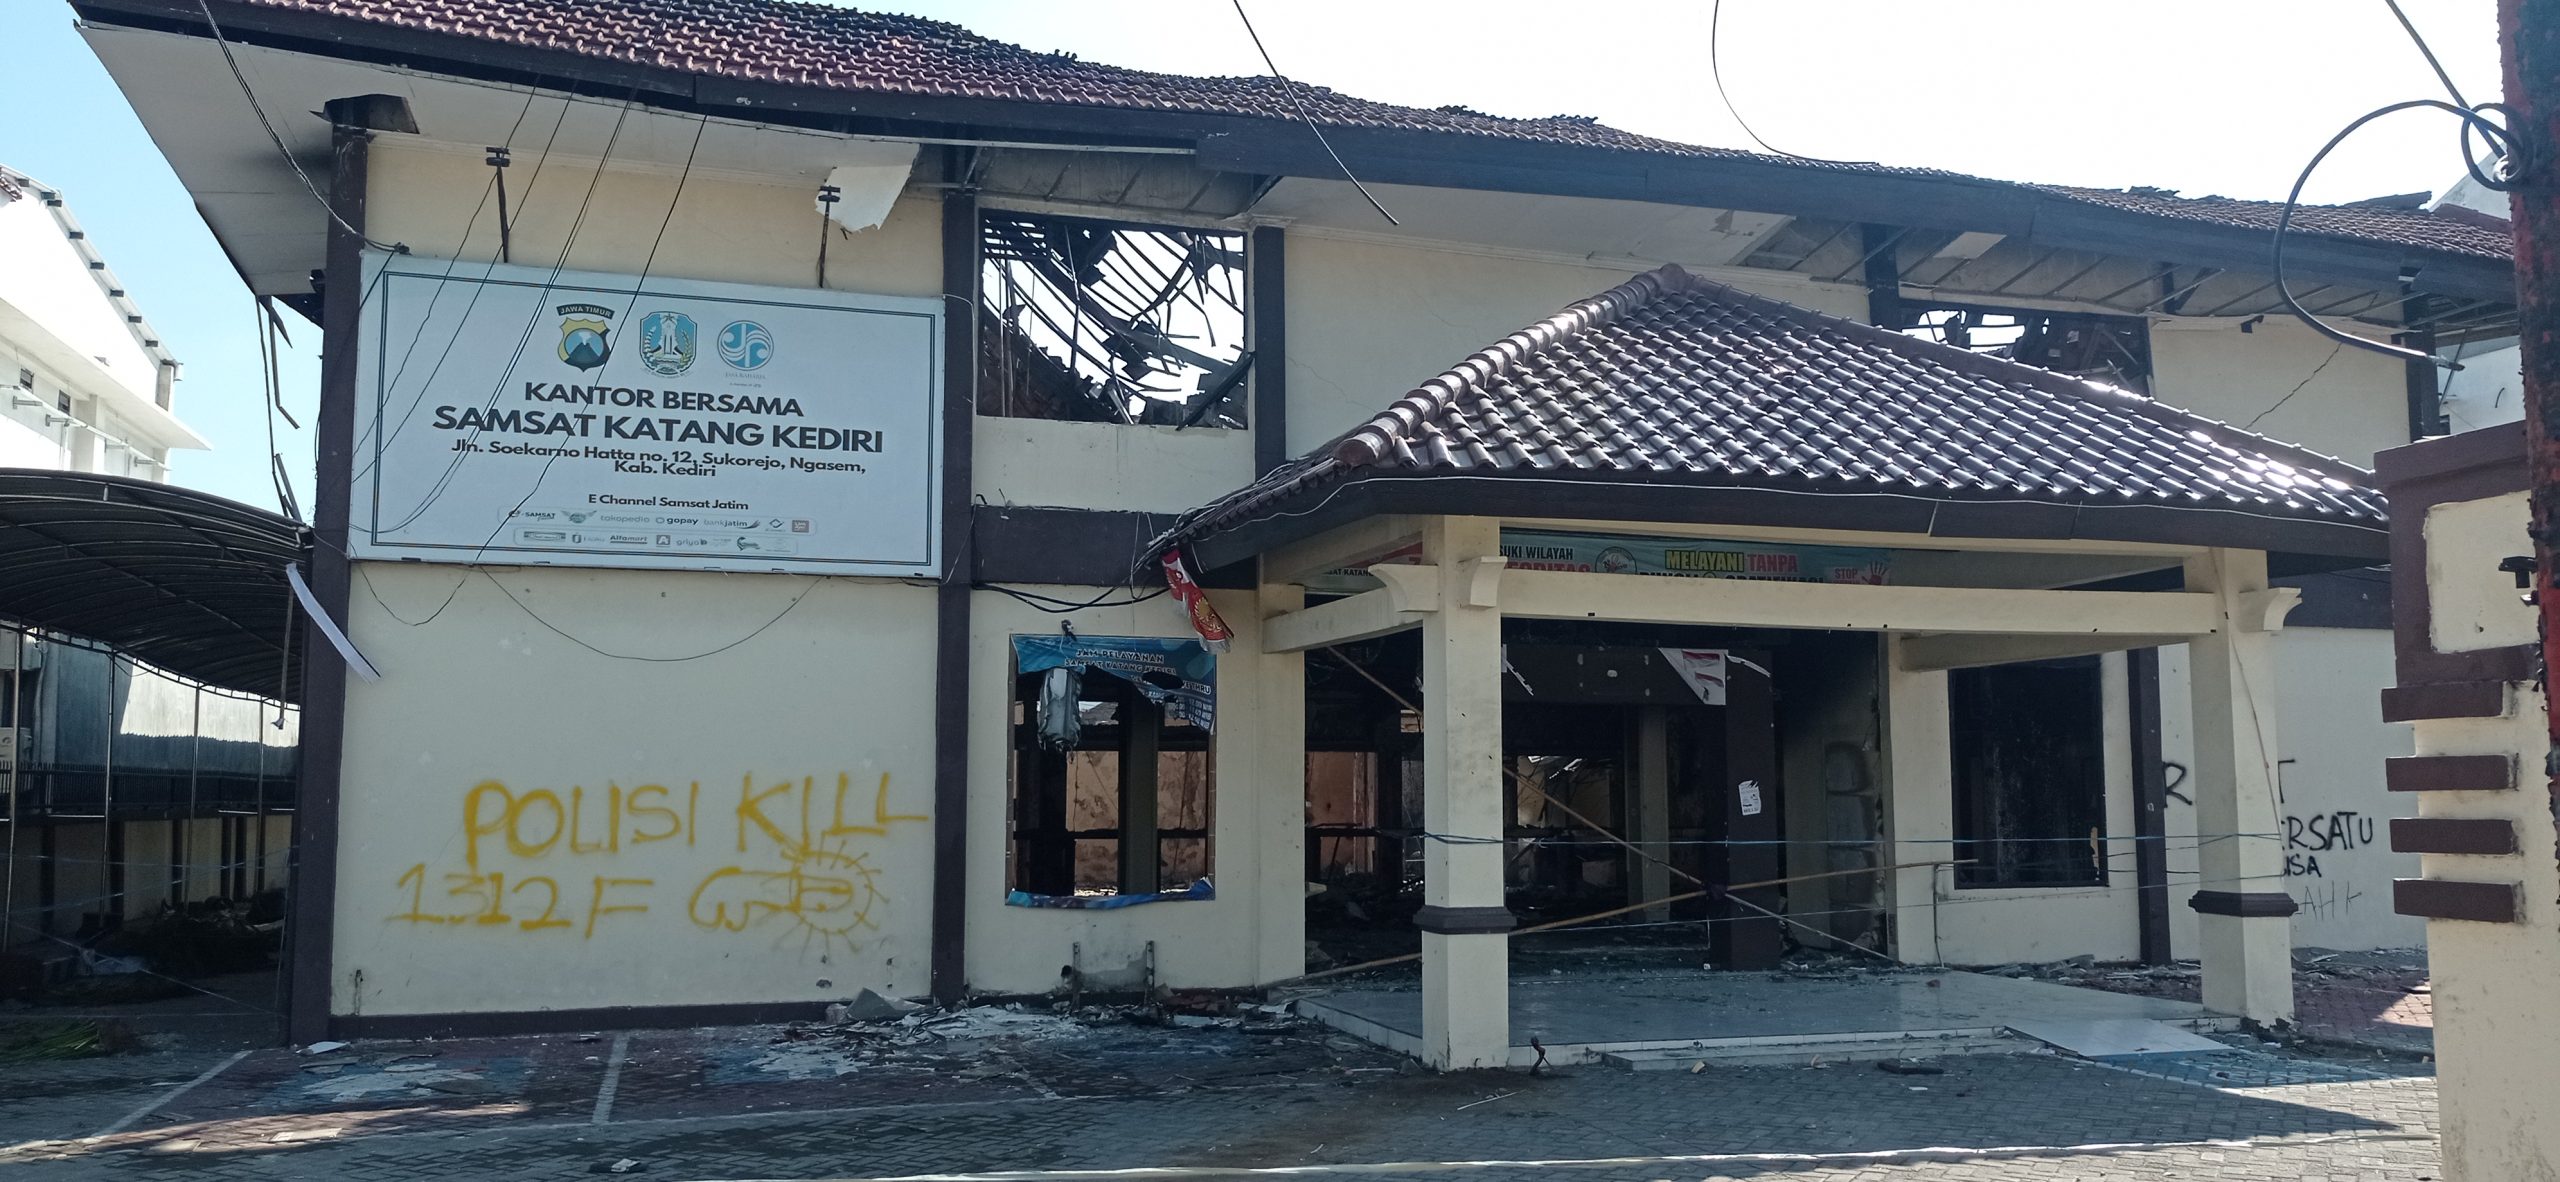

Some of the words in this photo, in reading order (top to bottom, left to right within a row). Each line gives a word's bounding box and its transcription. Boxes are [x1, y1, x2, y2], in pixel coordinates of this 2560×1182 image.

[560, 305, 583, 315] JAWA
[585, 305, 612, 318] TIMUR
[525, 382, 656, 409] KANTOR
[663, 390, 804, 417] BERSAMA
[432, 405, 596, 437] SAMSAT
[604, 415, 764, 446] KATANG
[772, 425, 883, 453] KEDIRI
[451, 438, 484, 452] Jln.
[489, 441, 580, 457] Soekarno
[584, 446, 635, 461] Hatta
[640, 451, 667, 462] no.
[672, 451, 698, 465] 12,
[702, 452, 785, 471] Sukorejo,
[790, 456, 866, 475] Ngasem,
[614, 460, 658, 474] Kab.
[663, 462, 716, 477] Kediri
[588, 494, 597, 504] E
[599, 494, 656, 506] Channel
[659, 496, 710, 508] Samsat
[712, 499, 749, 510] Jatim
[600, 515, 650, 523] tokopedia
[666, 516, 698, 526] gopay
[704, 518, 748, 528] bankjatim
[1526, 546, 1574, 560] WILAYAH
[1666, 550, 1743, 572] MELAYANI
[1747, 553, 1799, 573] TANPA
[1834, 567, 1858, 579] STOP
[1102, 649, 1165, 665] PELAYANAN
[463, 780, 699, 870] POLISI
[736, 771, 929, 853] KILL
[2281, 811, 2374, 851] RSATU
